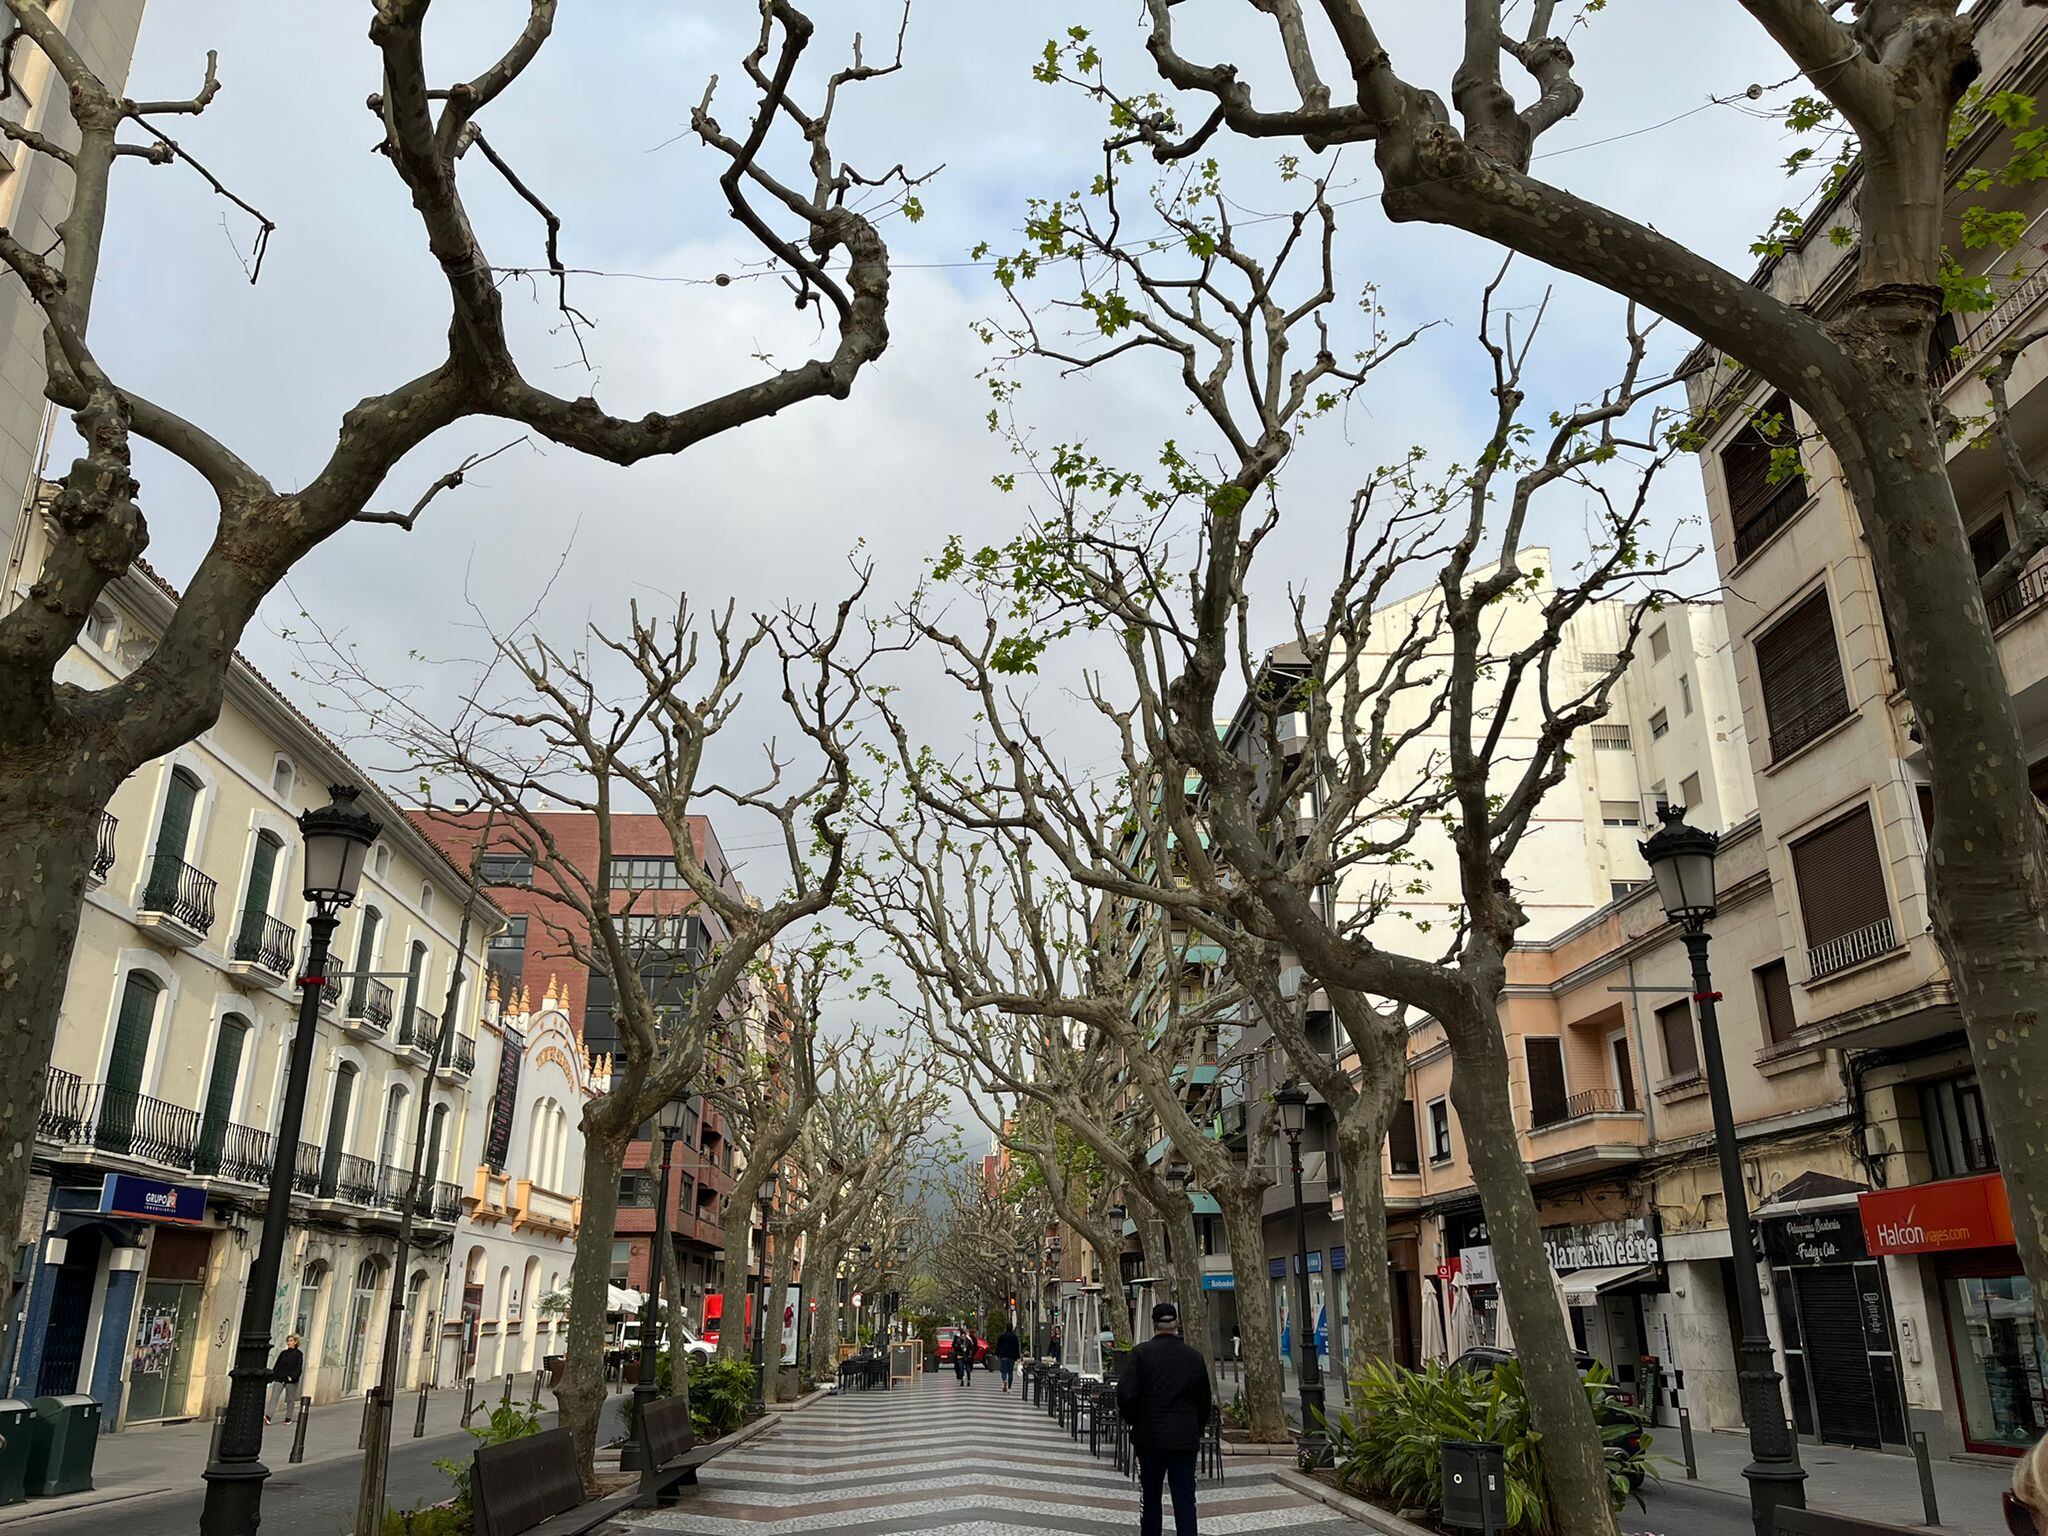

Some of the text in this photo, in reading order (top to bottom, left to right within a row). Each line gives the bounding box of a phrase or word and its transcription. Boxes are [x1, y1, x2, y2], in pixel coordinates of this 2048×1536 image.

[145, 1193, 167, 1205] GRUPO
[1543, 1241, 1590, 1270] Blanc
[1211, 1279, 1235, 1288] Sabadel
